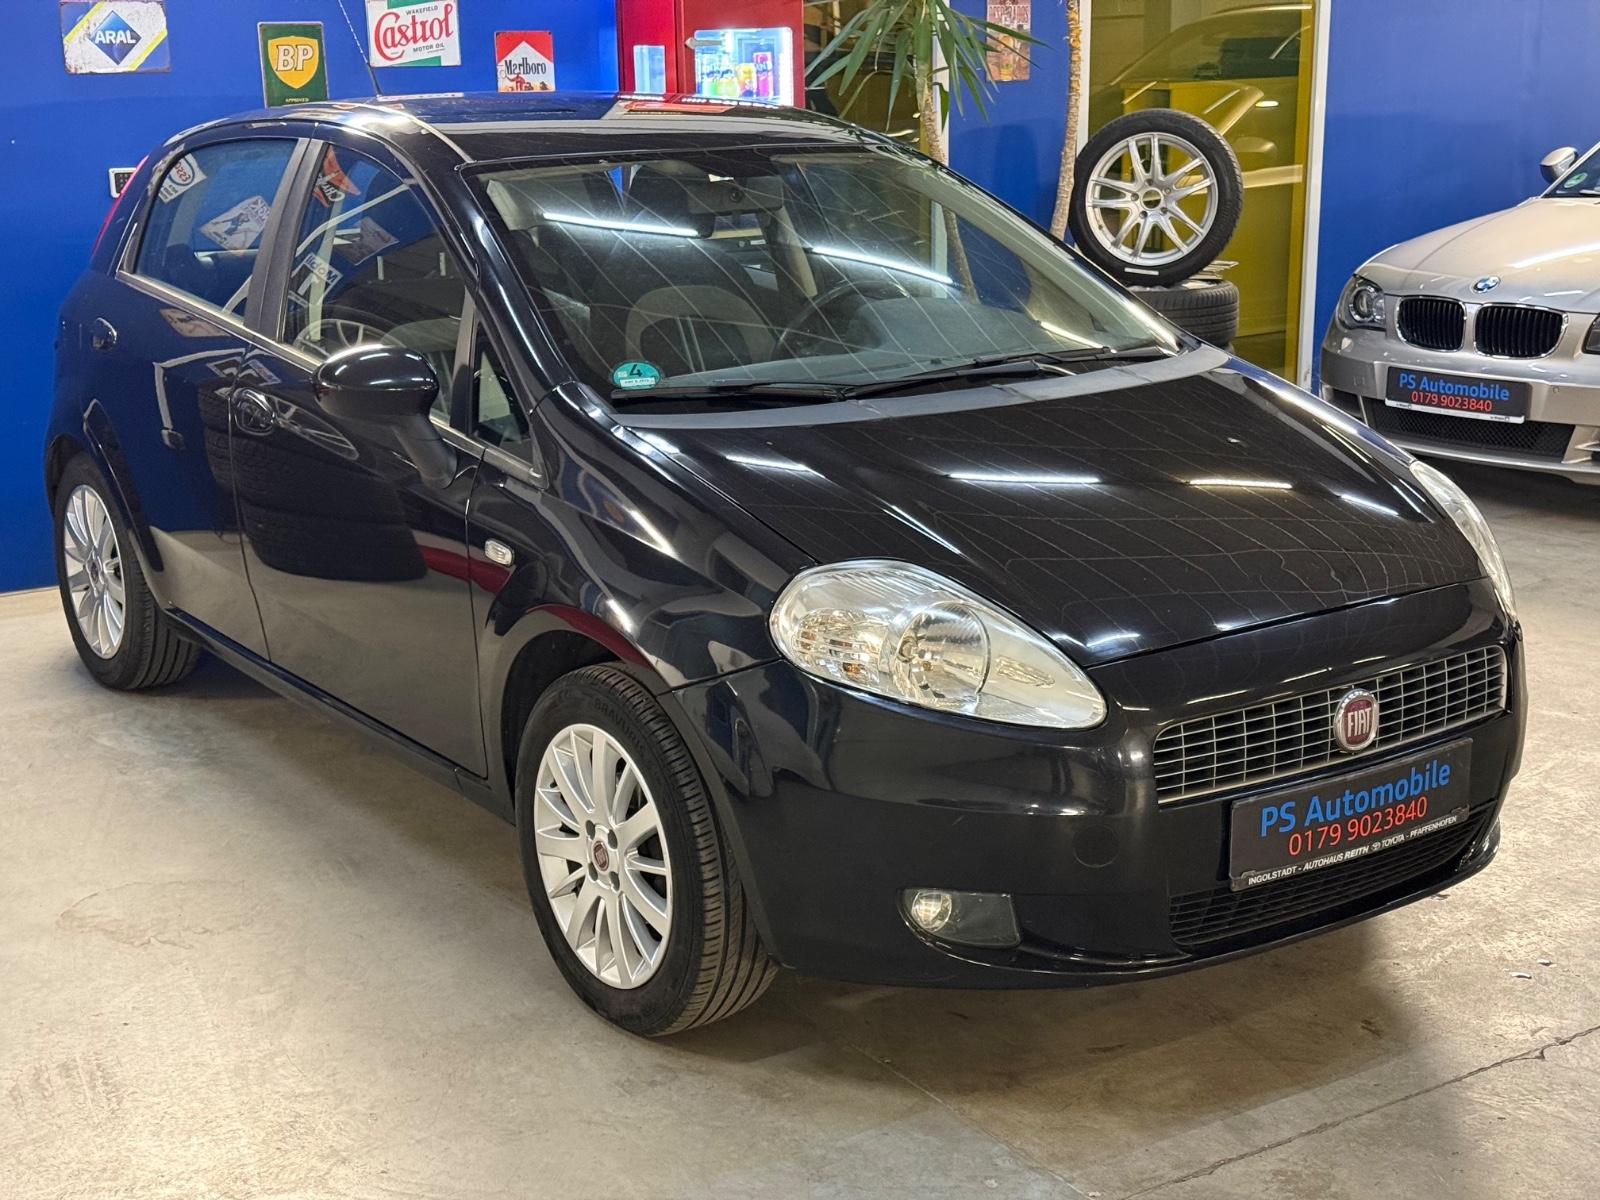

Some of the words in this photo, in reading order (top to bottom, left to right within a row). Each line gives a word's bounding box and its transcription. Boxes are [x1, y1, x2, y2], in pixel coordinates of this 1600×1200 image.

[405, 5, 439, 15] WAKEFIELD
[94, 29, 137, 44] ARAL
[374, 3, 454, 62] Castrol
[275, 44, 315, 72] BP
[504, 57, 547, 75] Marlboro
[629, 363, 643, 377] 4
[1399, 373, 1416, 389] PS
[1419, 376, 1510, 400] Automobile
[1411, 391, 1438, 405] 0179
[1440, 395, 1493, 412] 9023840
[1347, 707, 1371, 738] FIAT
[1261, 801, 1296, 837] PS
[1304, 759, 1451, 827] Automobile
[1289, 823, 1342, 856] 0179
[1347, 796, 1428, 841] 9023840
[1248, 865, 1298, 886] INGOLSTADT
[1303, 852, 1344, 872] AUTOHAUS
[1344, 846, 1370, 860] REITH
[1381, 834, 1405, 848] TOYOTA
[1410, 815, 1458, 839] PFAFFENHOFEN
